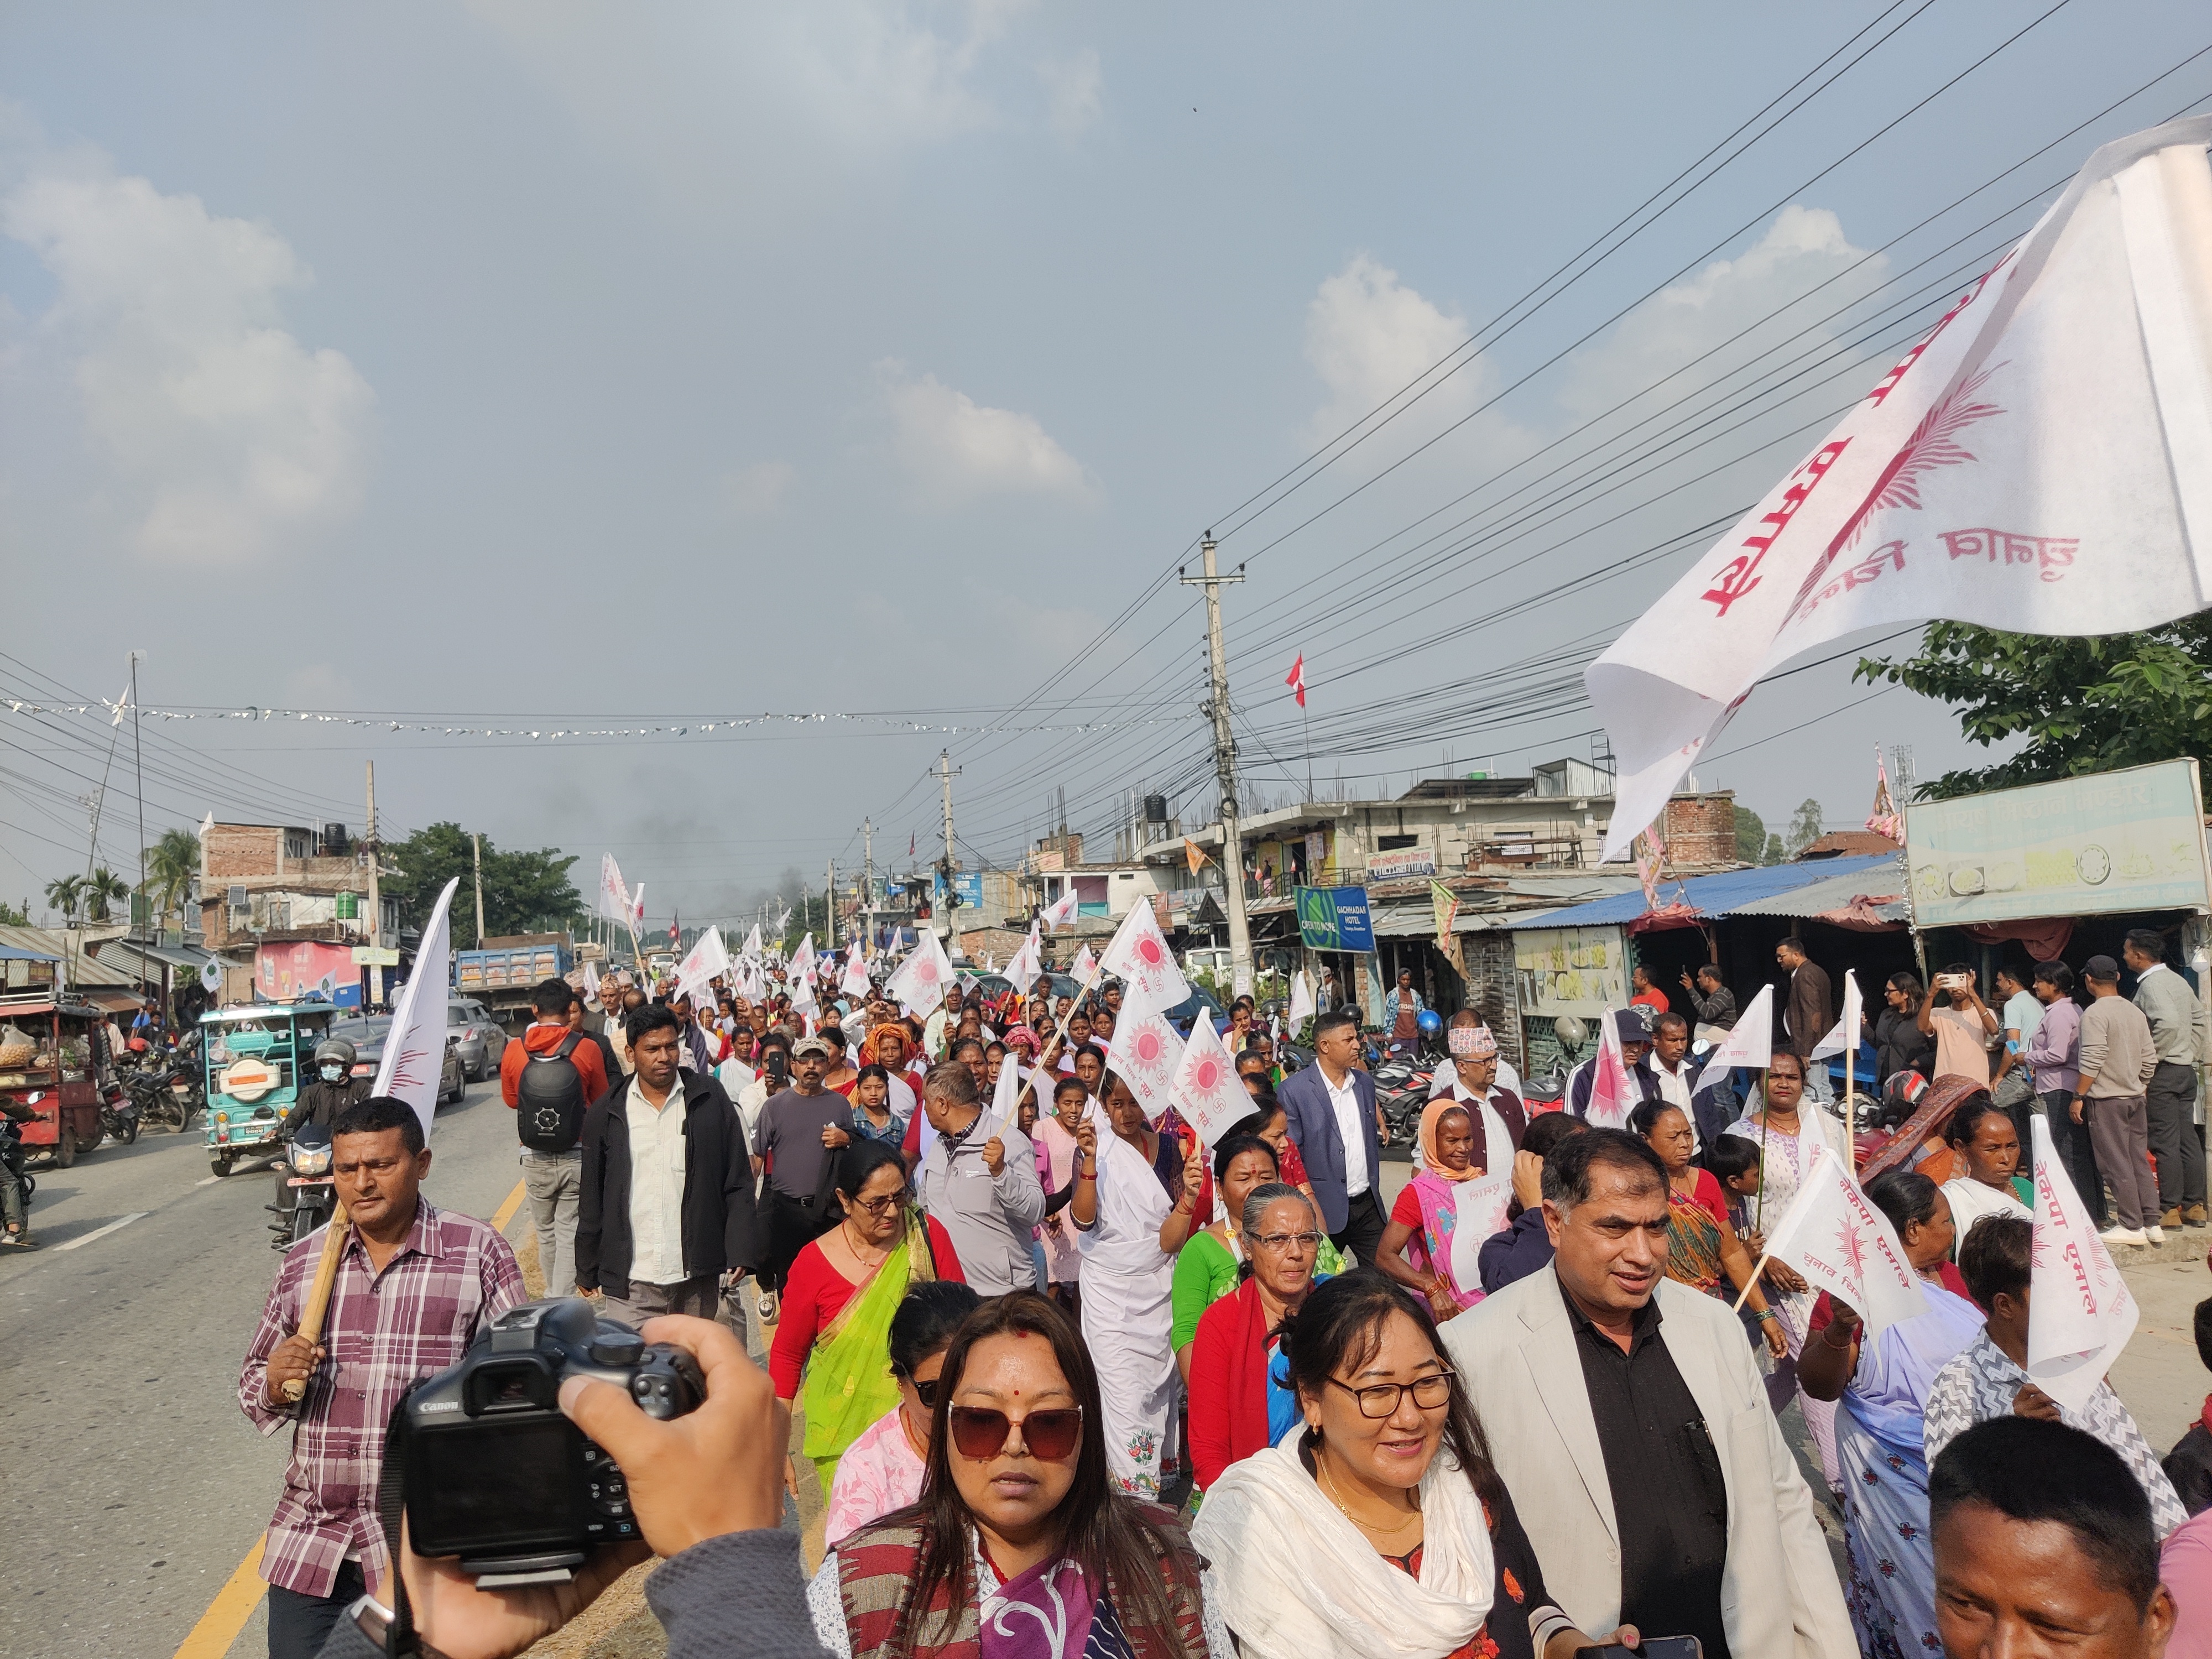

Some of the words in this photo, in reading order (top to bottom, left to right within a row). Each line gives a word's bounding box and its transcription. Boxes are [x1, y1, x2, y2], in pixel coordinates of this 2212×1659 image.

[1314, 921, 1321, 931] TO
[1344, 916, 1360, 925] HOTEL
[1840, 1177, 1877, 1227] नेकपा
[1876, 1234, 1911, 1290] एमाले
[2035, 1159, 2069, 1229] नेकपा
[2062, 1241, 2098, 1317] एमाले
[1803, 1251, 1837, 1278] चुनाव
[419, 1401, 458, 1412] Canon
